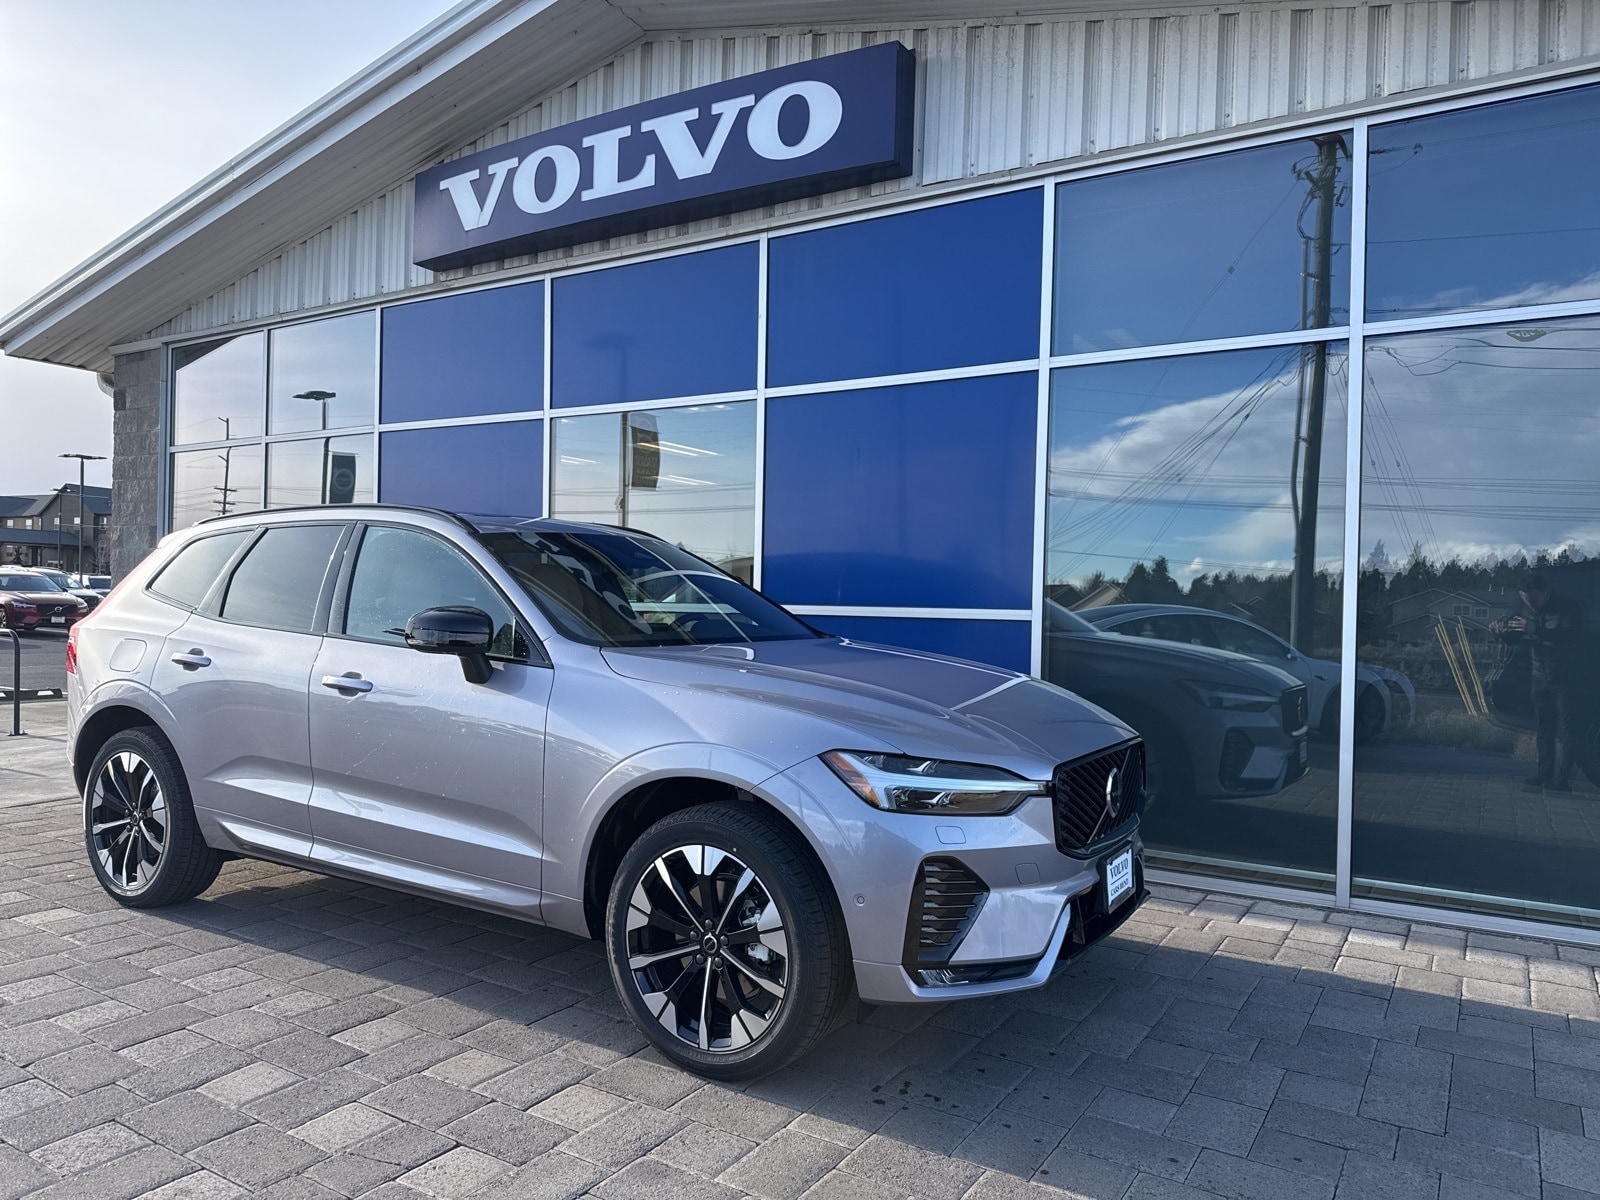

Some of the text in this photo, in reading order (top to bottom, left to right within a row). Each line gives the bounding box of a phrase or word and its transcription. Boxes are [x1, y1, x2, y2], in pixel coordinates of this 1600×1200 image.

[439, 80, 843, 232] VOLVO
[1109, 857, 1129, 879] VOLVO
[1110, 884, 1120, 897] CARS
